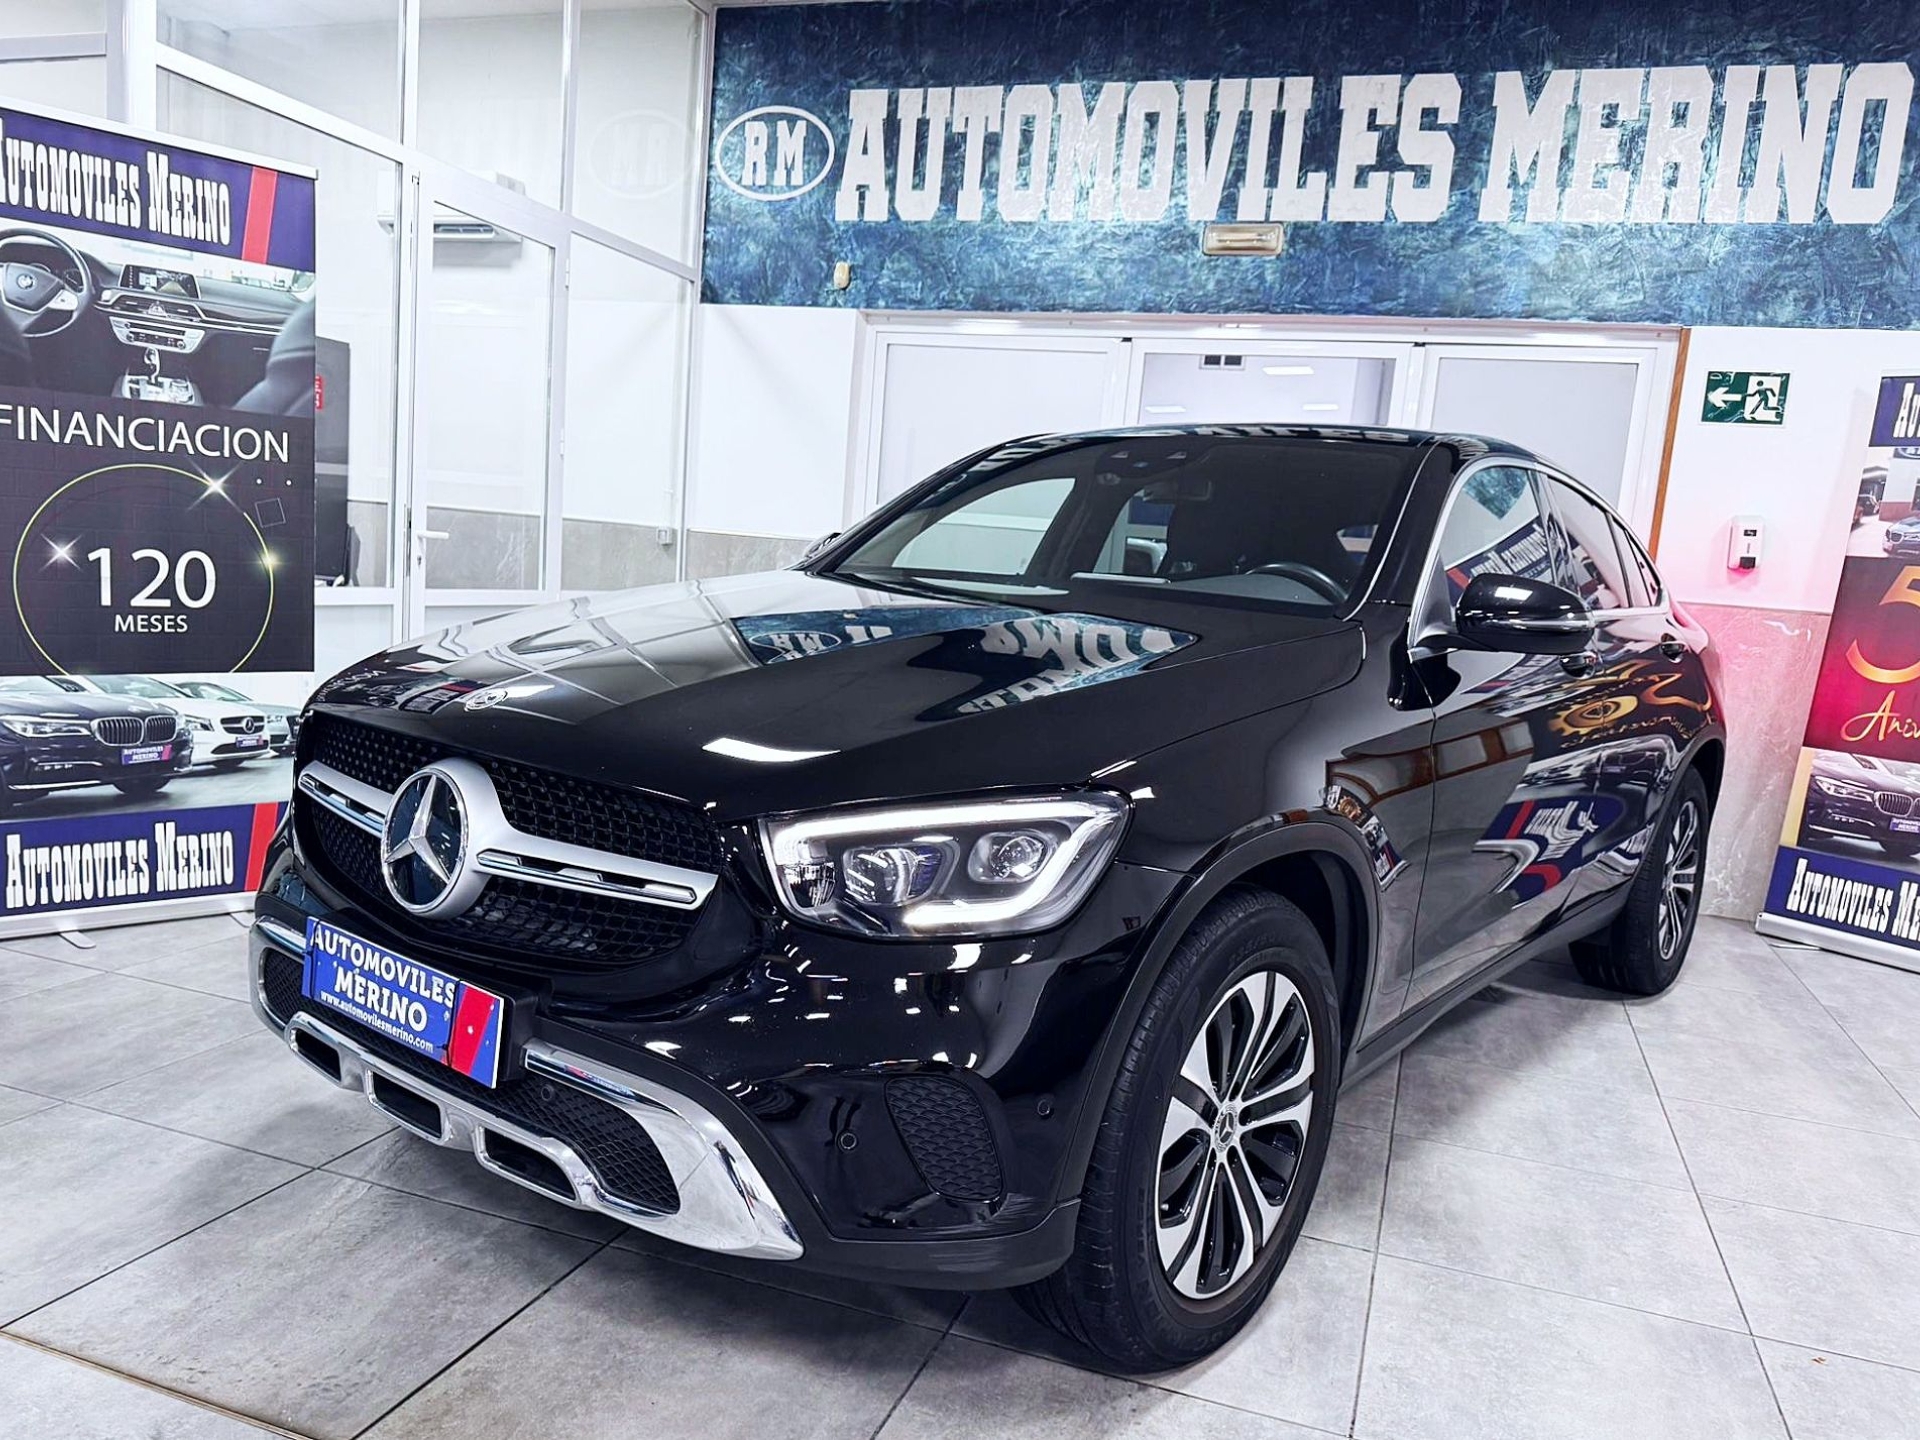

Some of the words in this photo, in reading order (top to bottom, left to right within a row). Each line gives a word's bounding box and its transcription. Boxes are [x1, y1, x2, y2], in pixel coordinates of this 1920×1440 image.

[741, 120, 807, 187] RM
[835, 73, 1462, 222] AUTOMOVILES
[1478, 62, 1915, 224] MERINO
[147, 151, 230, 246] MERINO
[88, 548, 216, 608] 120
[115, 614, 188, 632] MESES
[6, 834, 149, 909] AUTOMOVILES
[155, 822, 233, 892] MERINO
[1786, 858, 1894, 933] AUTOMOVILES
[310, 924, 455, 1008] AUTOMOVILES
[334, 967, 427, 1031] MERINO
[320, 990, 434, 1054] www.automovilesmerino.com
